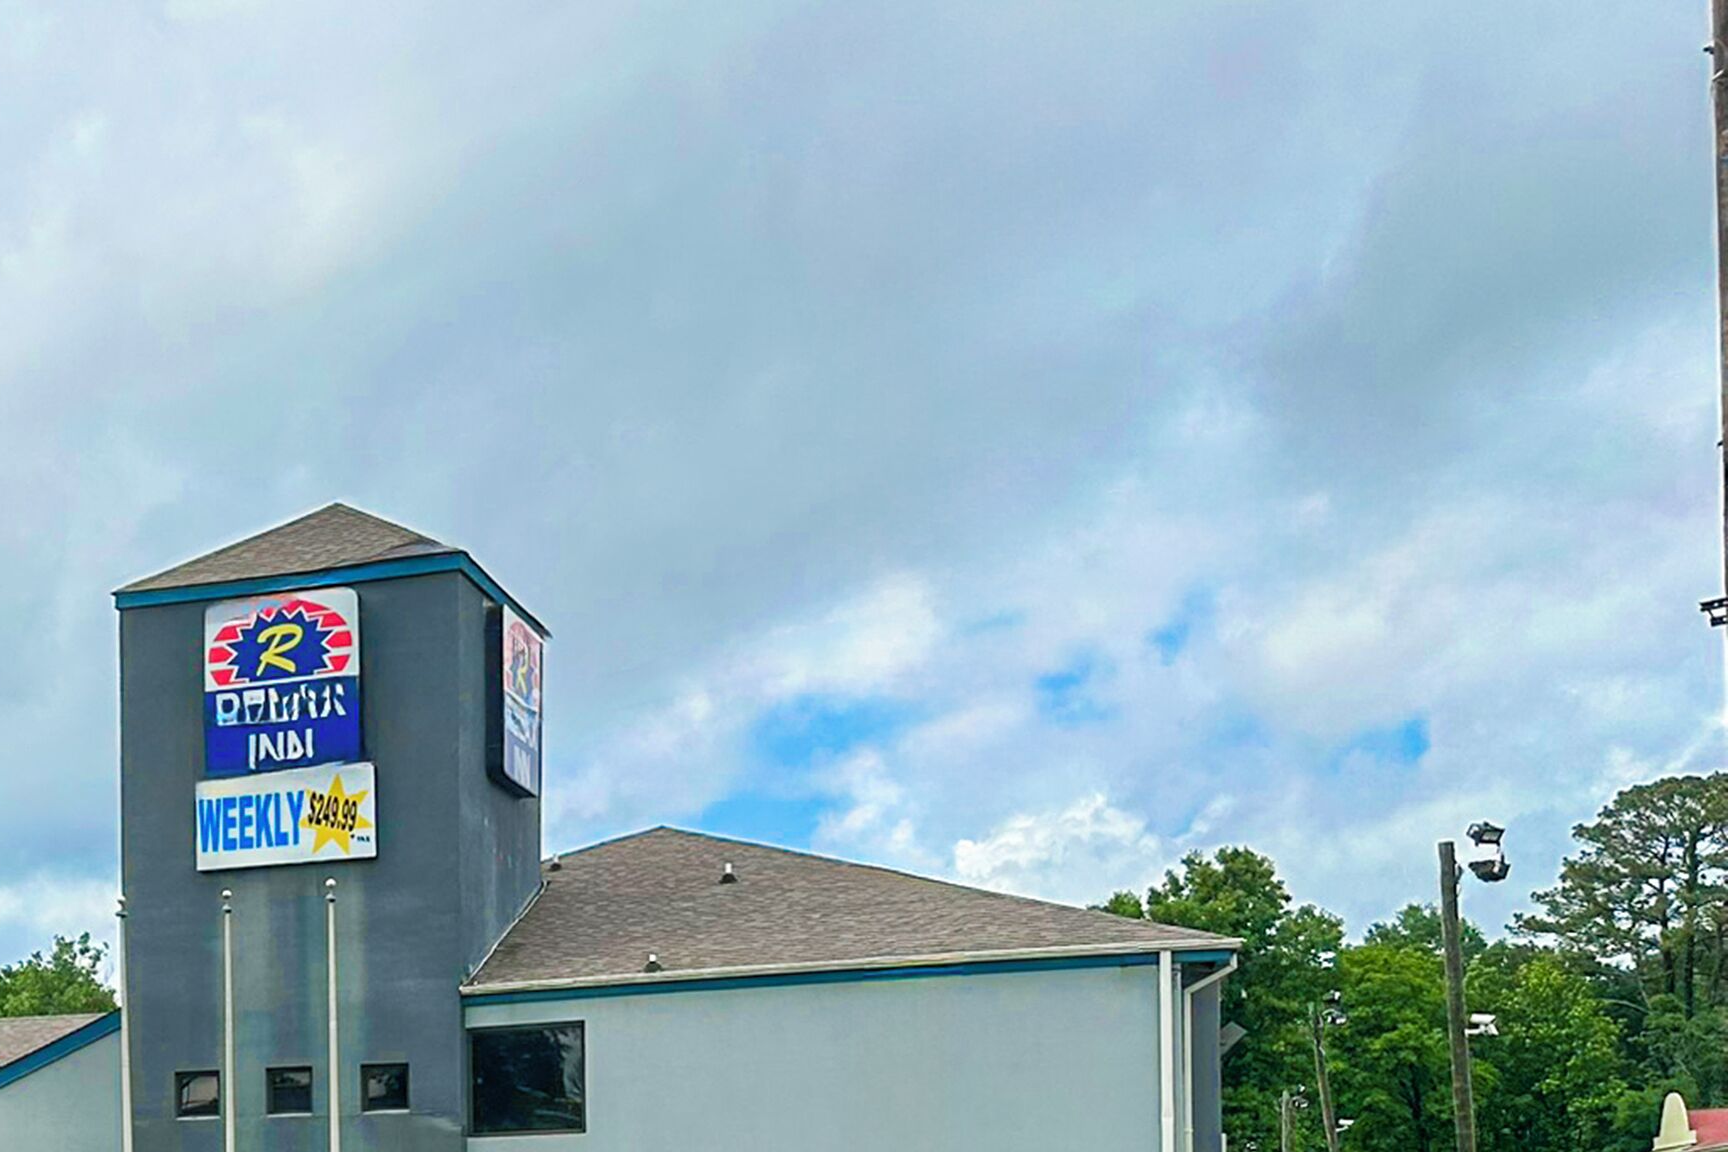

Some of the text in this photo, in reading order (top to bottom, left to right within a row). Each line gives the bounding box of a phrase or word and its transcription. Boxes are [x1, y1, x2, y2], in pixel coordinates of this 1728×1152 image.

[257, 623, 304, 677] R
[197, 790, 358, 853] WEEKLY $249.99
